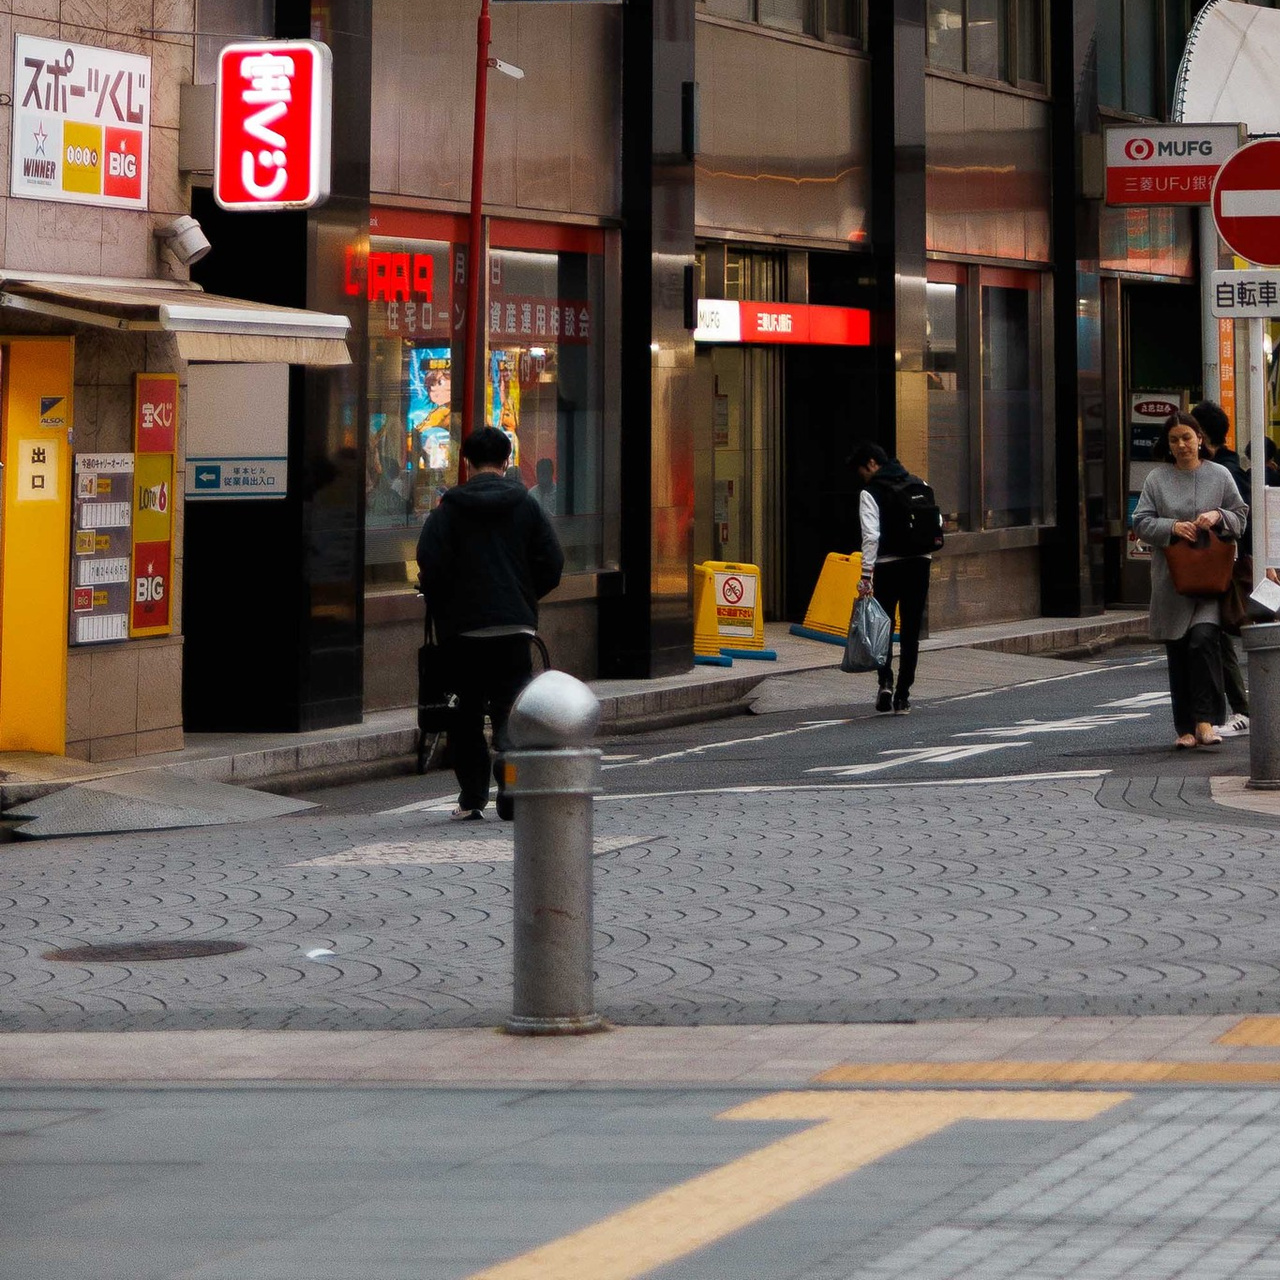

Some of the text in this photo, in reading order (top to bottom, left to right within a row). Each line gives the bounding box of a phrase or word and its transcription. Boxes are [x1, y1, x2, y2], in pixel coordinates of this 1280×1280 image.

[21, 48, 146, 124] スポーツくじ
[240, 53, 295, 198] 宝くじ
[1157, 141, 1213, 156] MUFG
[23, 157, 56, 180] WINNER
[109, 150, 137, 178] BIG
[490, 299, 591, 338] 資産運用相談会
[142, 402, 173, 428] 宝くじ
[31, 447, 47, 490] 出口
[223, 476, 275, 486] 従業員出入口
[135, 575, 164, 602] BIG
